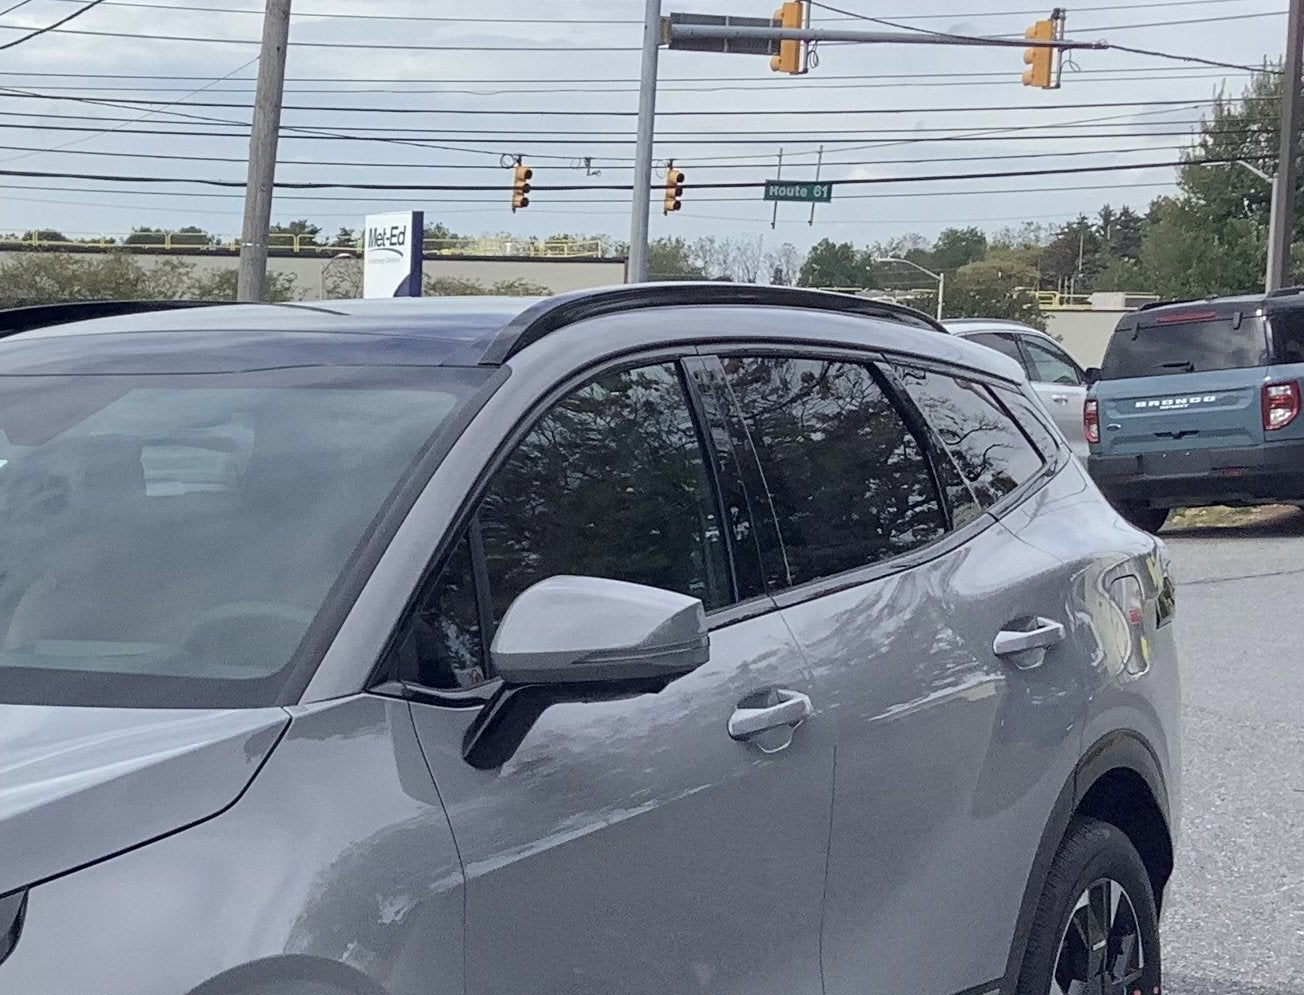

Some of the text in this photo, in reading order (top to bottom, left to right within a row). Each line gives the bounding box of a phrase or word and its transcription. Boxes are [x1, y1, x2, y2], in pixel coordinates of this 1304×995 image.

[769, 185, 829, 198] Route 61
[368, 225, 406, 249] Met-Ed
[1135, 396, 1216, 408] BRONCO
